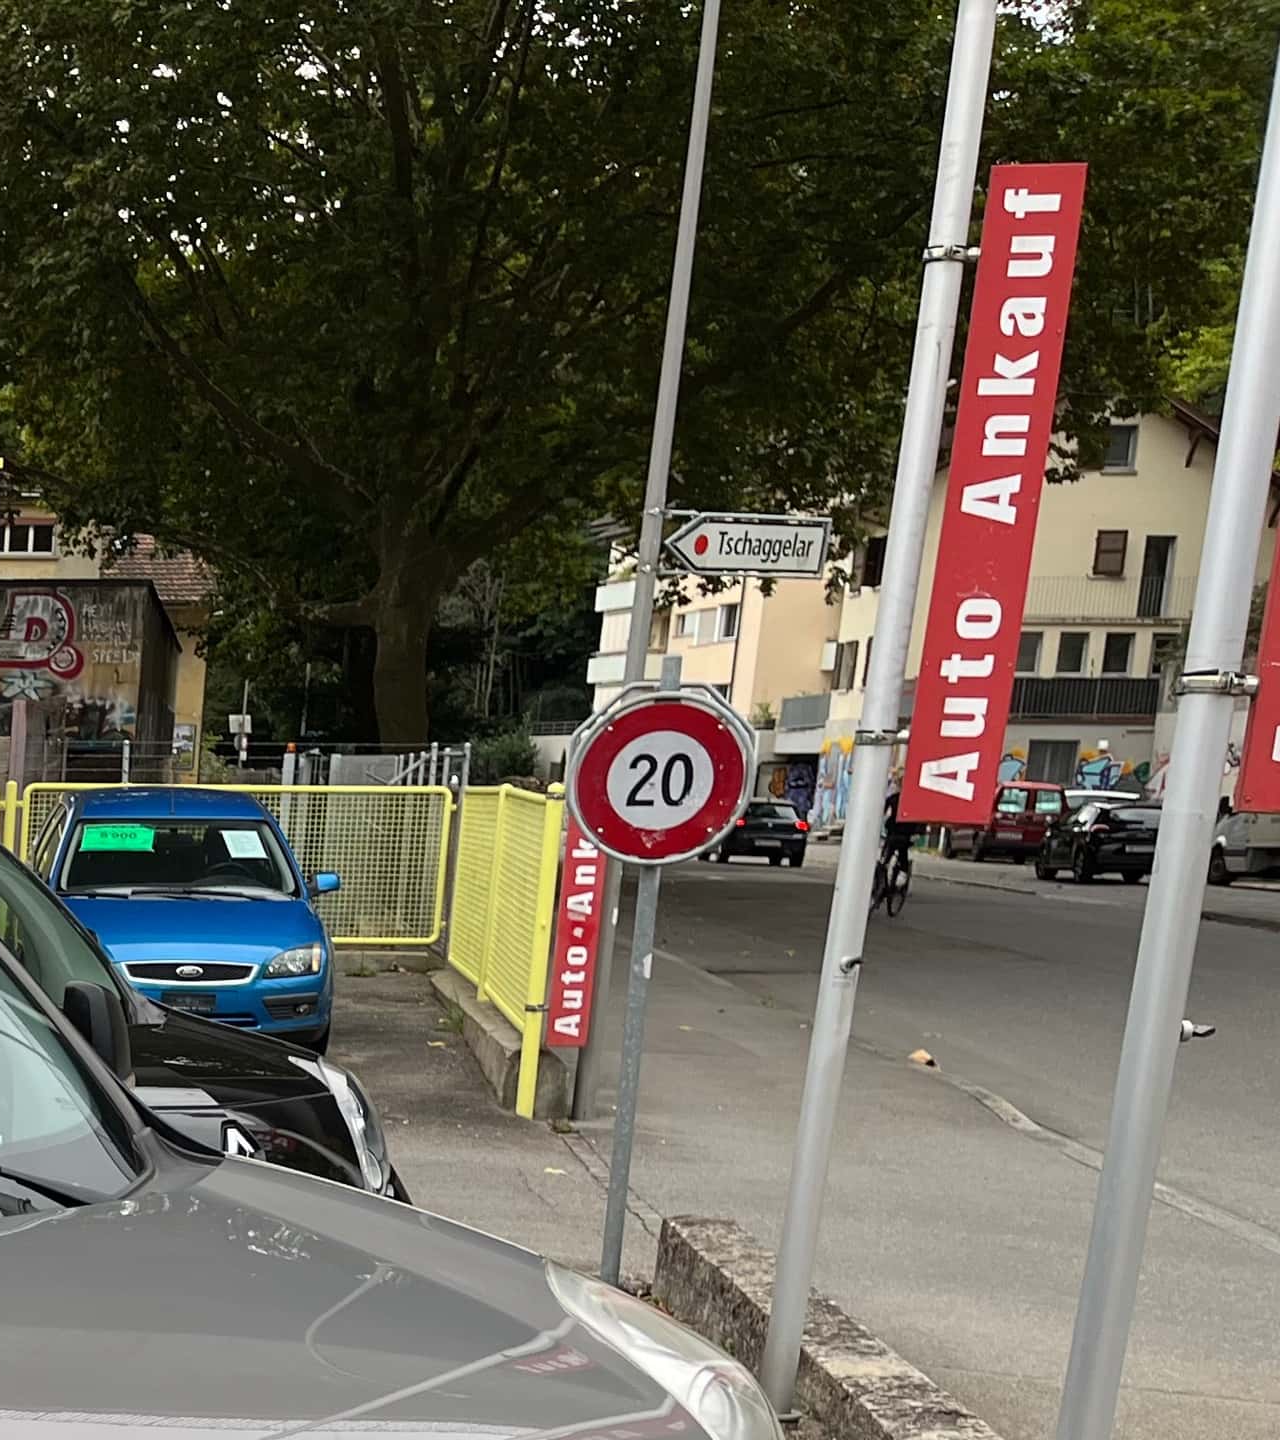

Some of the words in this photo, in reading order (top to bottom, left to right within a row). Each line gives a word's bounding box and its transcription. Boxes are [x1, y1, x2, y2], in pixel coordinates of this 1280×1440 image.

[960, 186, 1062, 526] Ankauf
[717, 529, 815, 562] Tschaggelar
[919, 597, 1004, 802] Auto
[626, 752, 695, 808] 20
